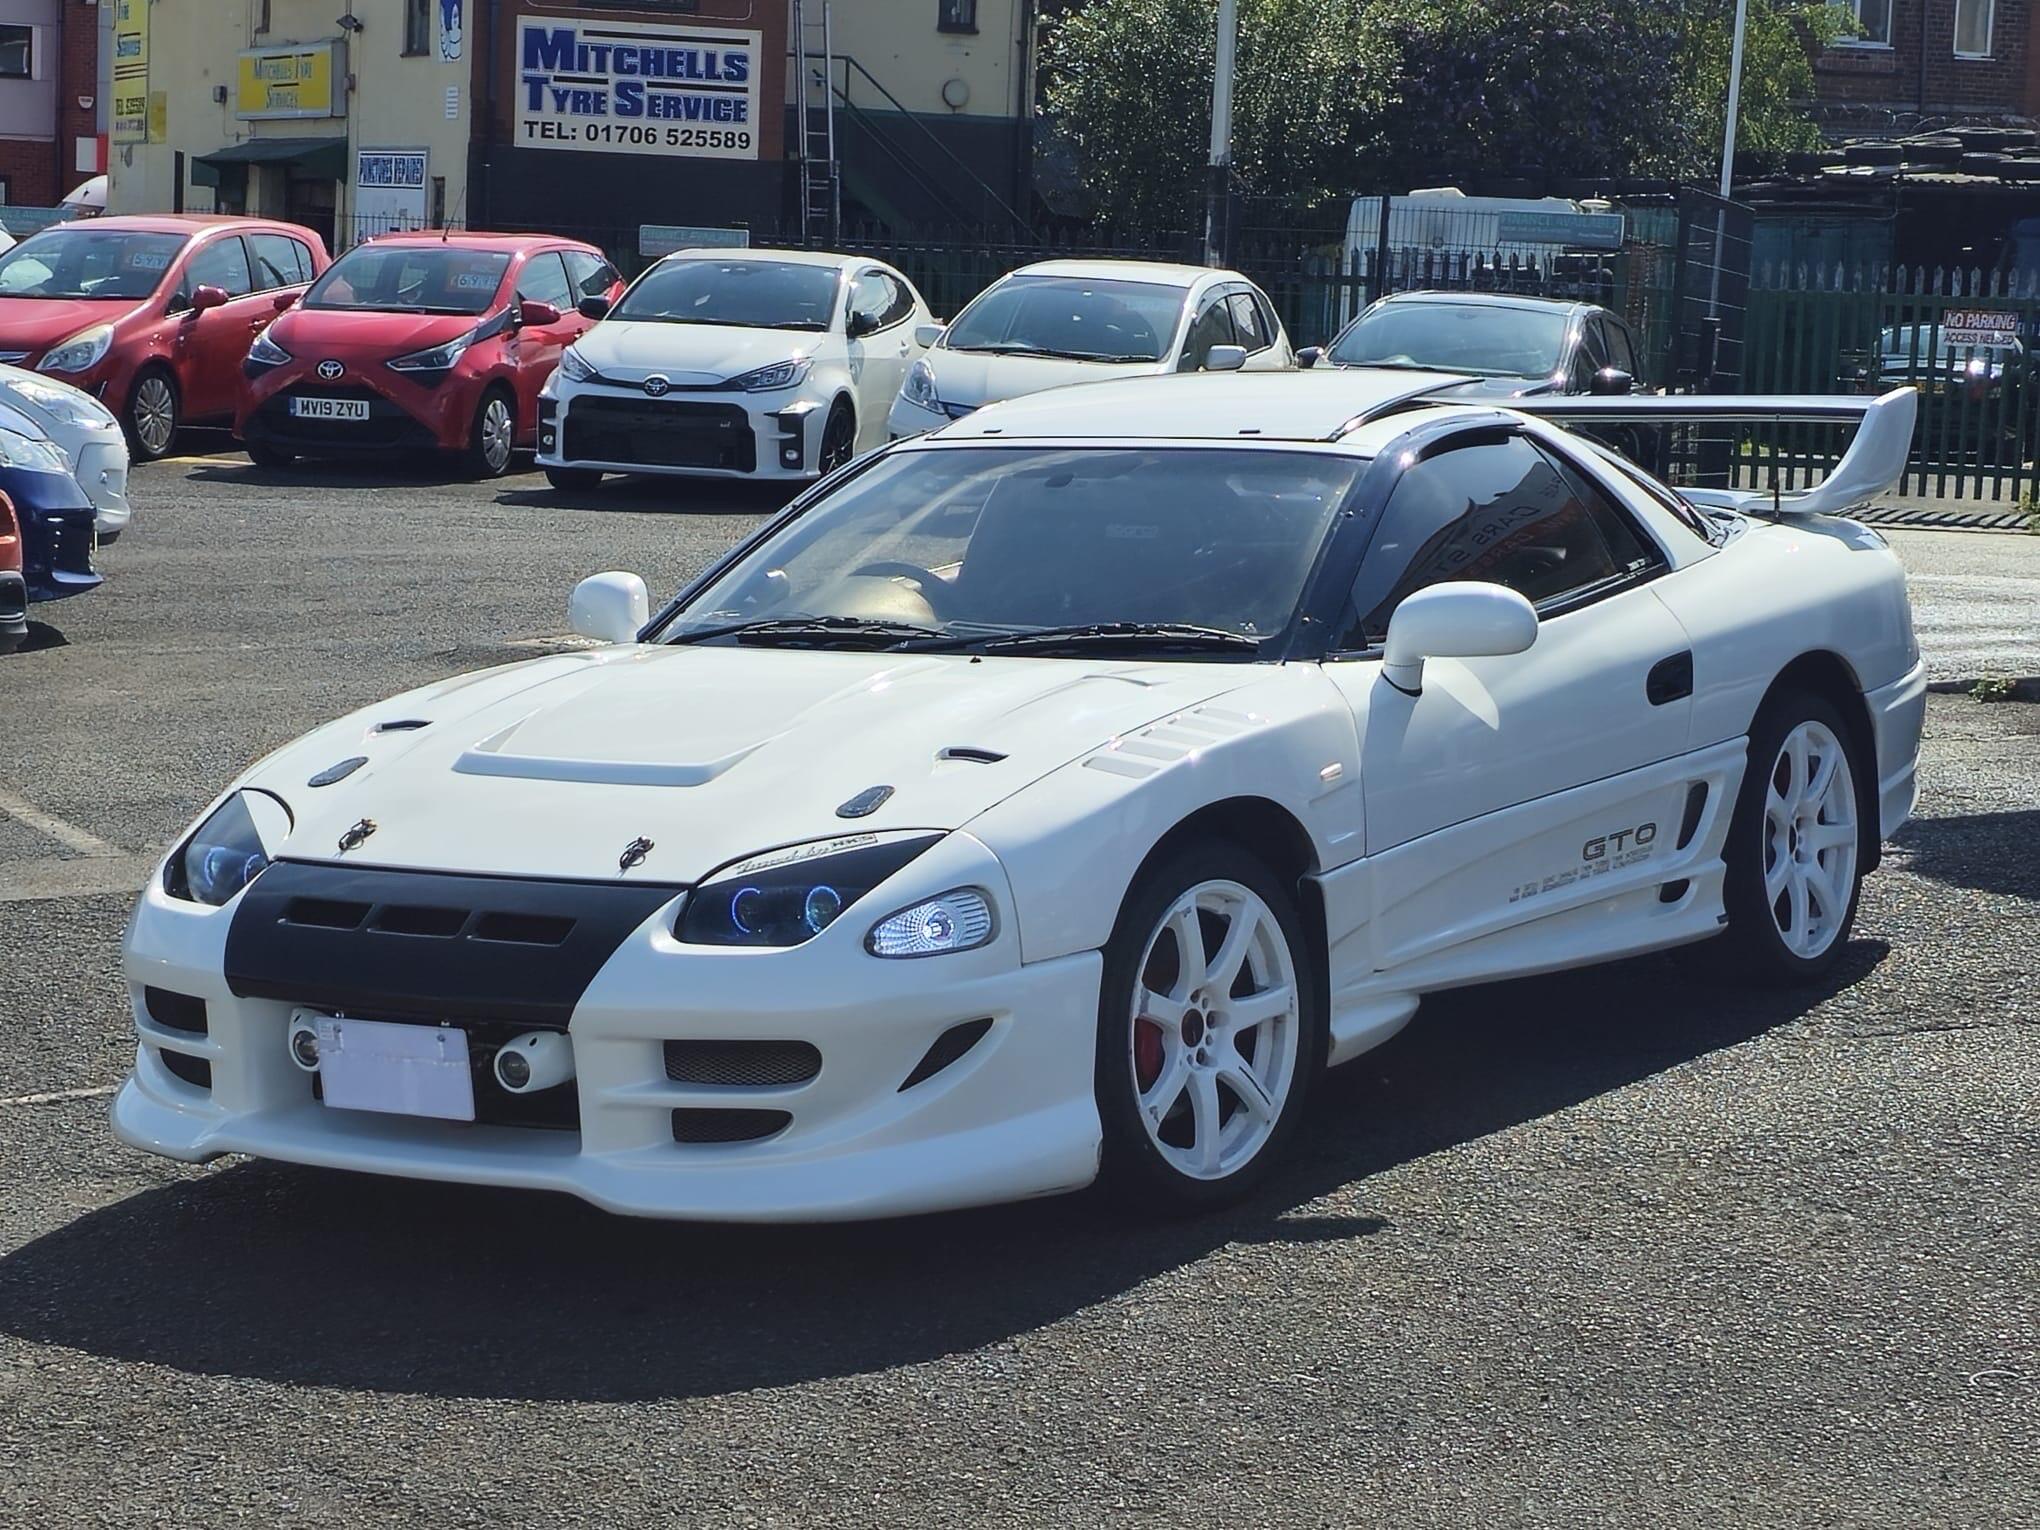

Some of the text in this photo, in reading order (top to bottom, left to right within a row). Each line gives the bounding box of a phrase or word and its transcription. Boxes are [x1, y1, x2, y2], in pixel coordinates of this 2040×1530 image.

[522, 25, 749, 82] MITCHELLS
[522, 73, 749, 125] TYRE SERVICE
[523, 120, 751, 150] TEL: 01706 525589
[1946, 312, 2016, 330] NO PARKING
[301, 400, 364, 417] MV19 ZYU
[1582, 822, 1657, 861] GTO
